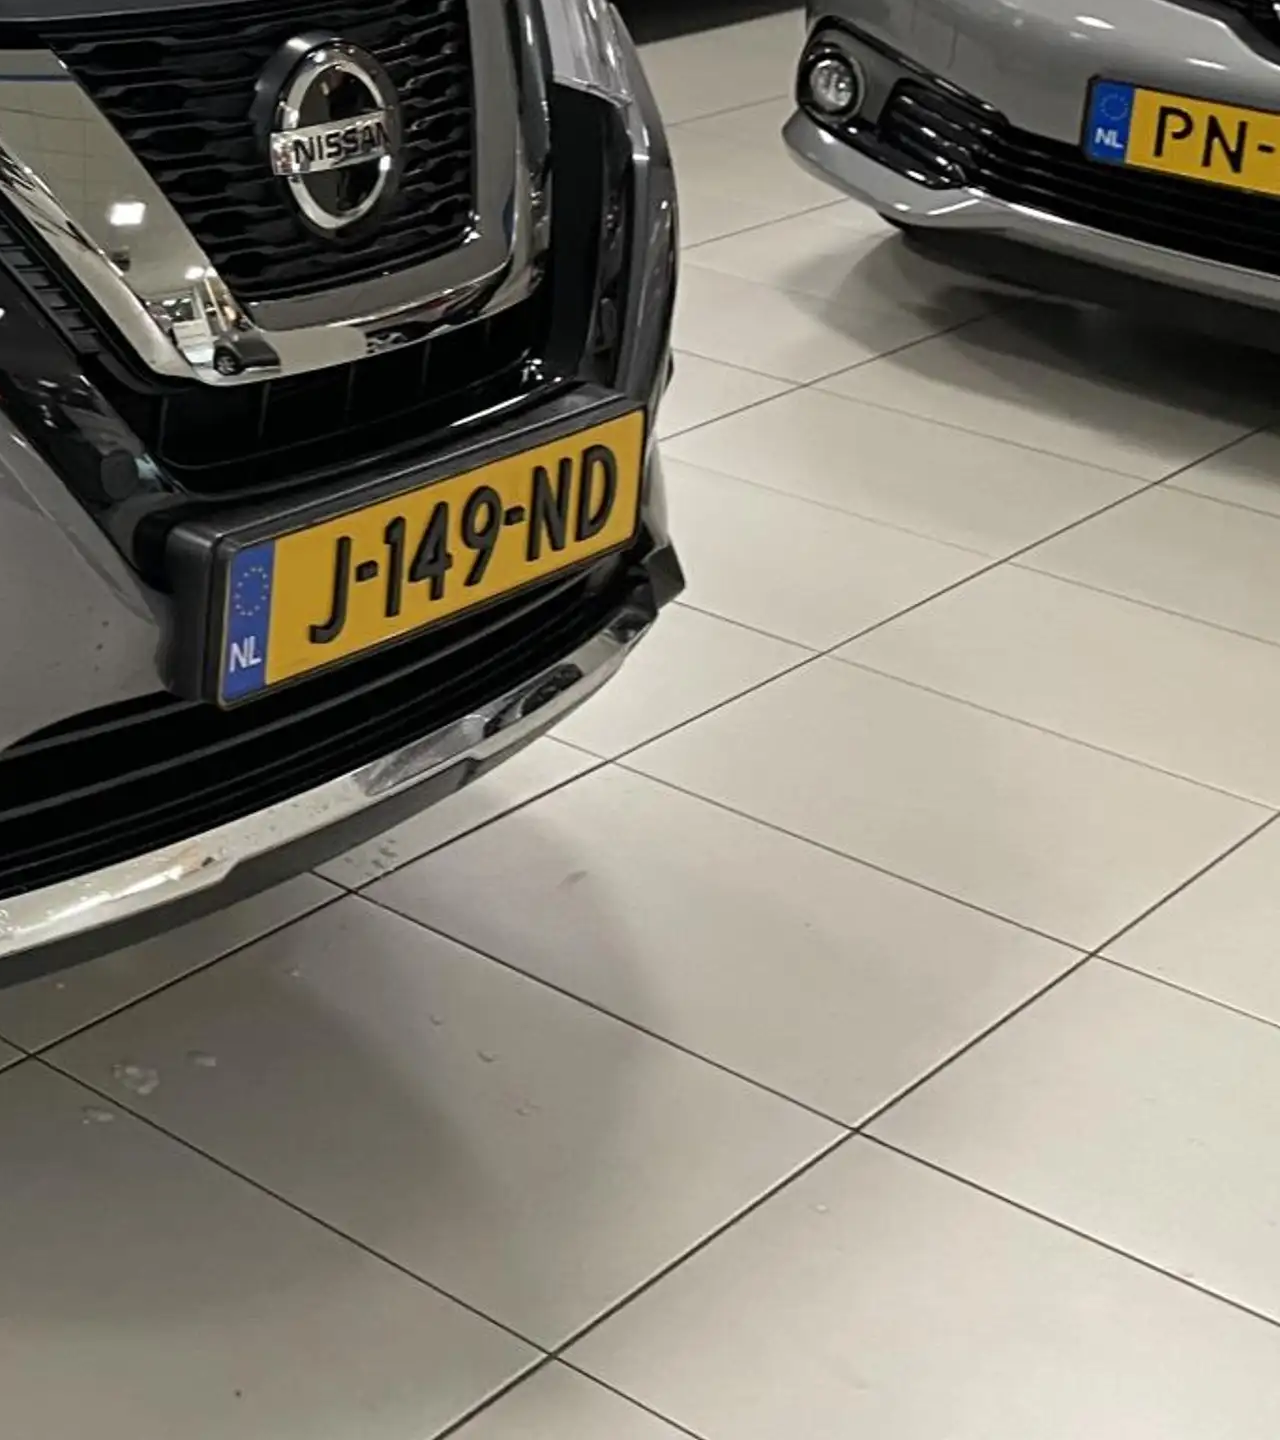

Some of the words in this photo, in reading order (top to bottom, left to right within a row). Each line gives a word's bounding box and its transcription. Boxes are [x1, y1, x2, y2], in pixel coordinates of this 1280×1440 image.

[1095, 127, 1124, 149] NL
[308, 444, 618, 645] J-149-ND
[229, 641, 261, 673] NL
